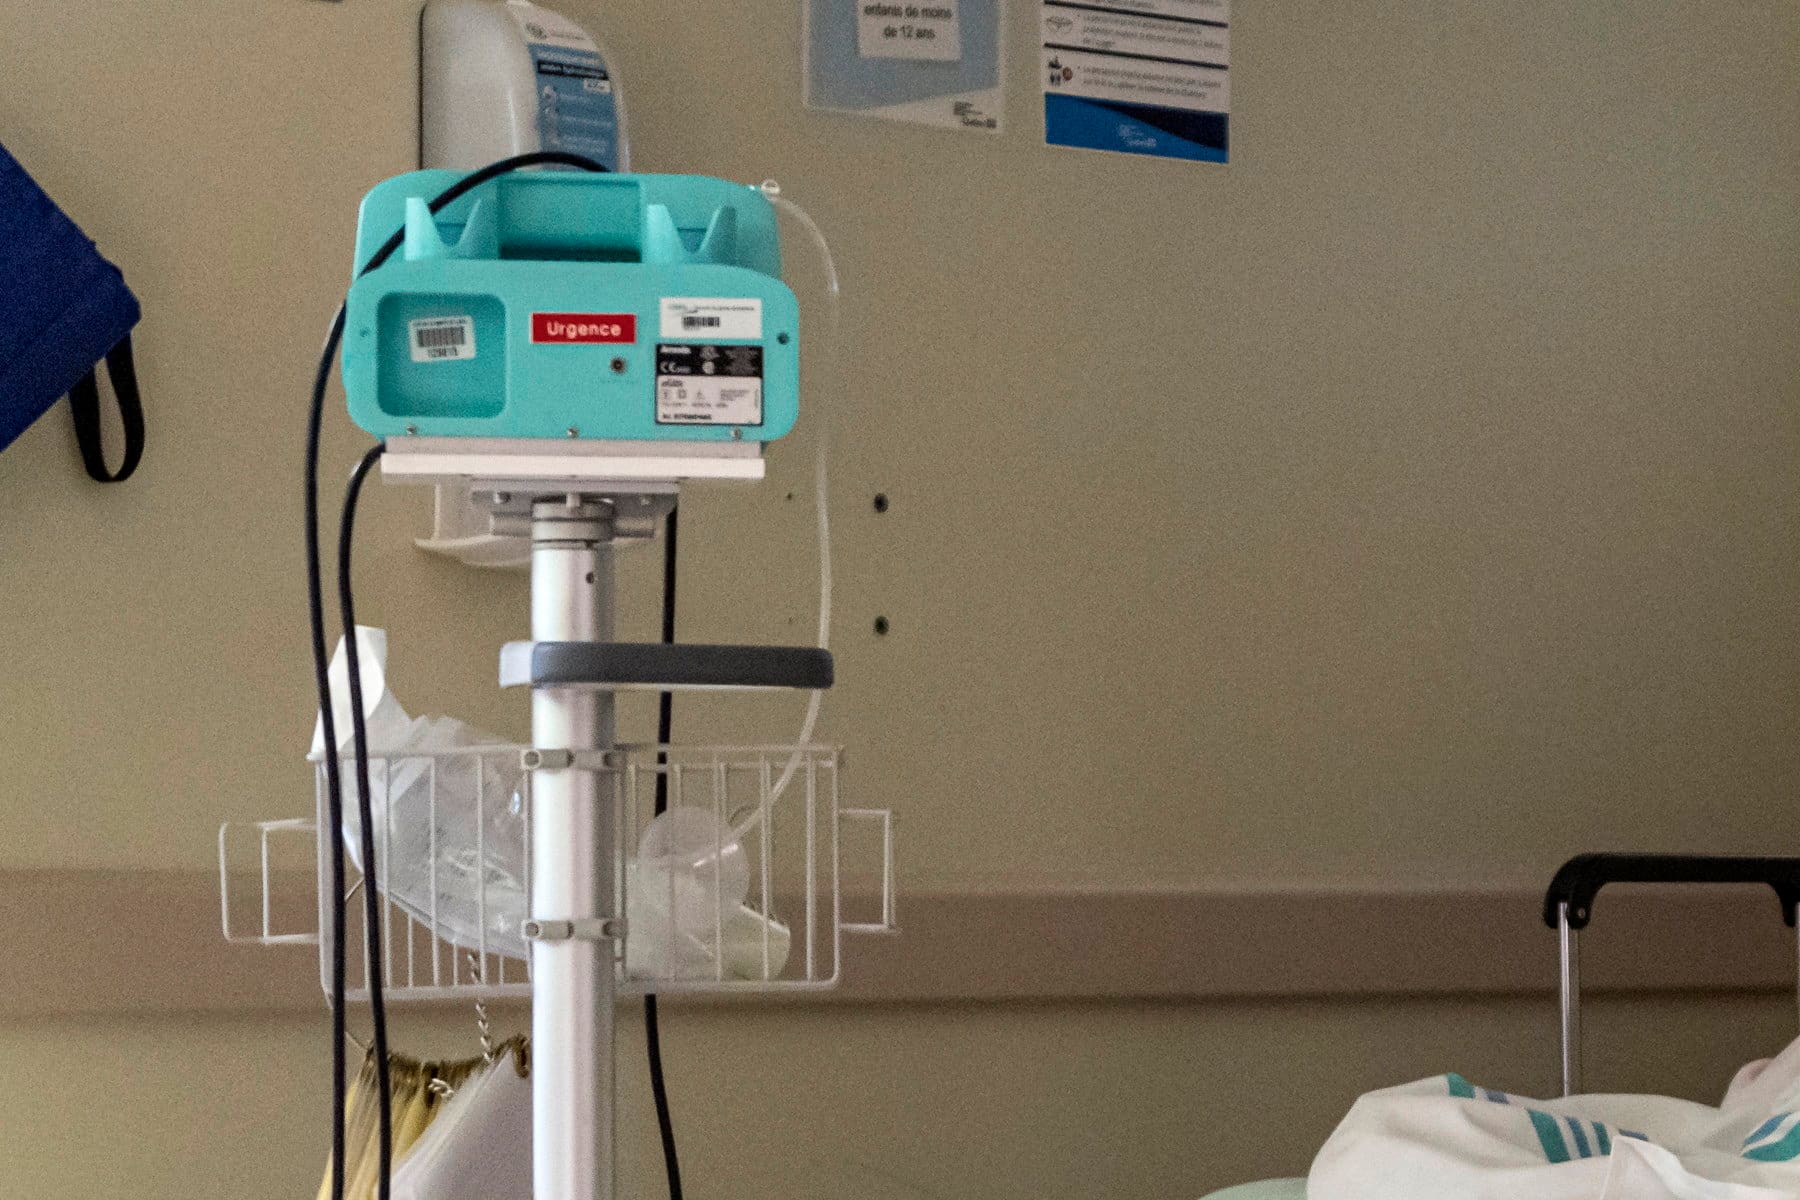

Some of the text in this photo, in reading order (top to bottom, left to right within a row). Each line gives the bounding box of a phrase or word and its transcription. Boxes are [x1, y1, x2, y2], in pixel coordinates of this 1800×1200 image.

[864, 3, 953, 19] enfants de moins
[883, 25, 936, 39] de 12 ans
[546, 321, 622, 339] Urgence
